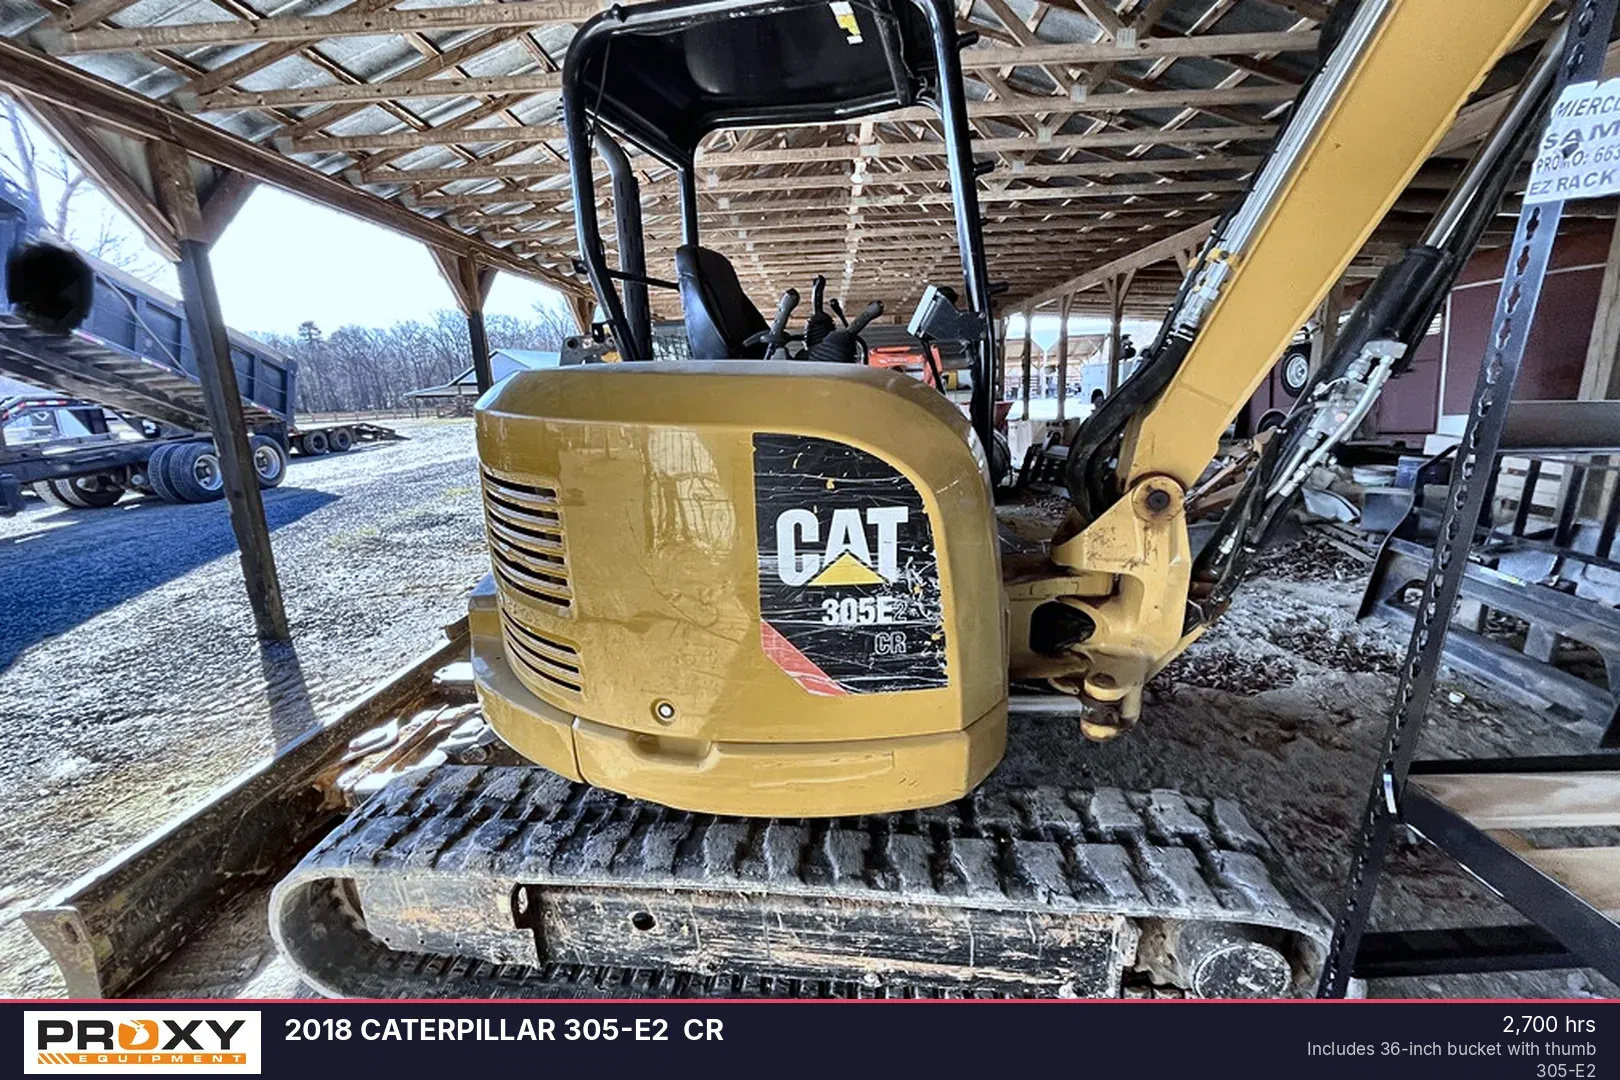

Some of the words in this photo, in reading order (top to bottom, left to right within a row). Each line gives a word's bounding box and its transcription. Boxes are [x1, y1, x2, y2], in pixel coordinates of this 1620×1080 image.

[1529, 180, 1552, 196] EZ
[1556, 168, 1617, 192] RACK
[776, 506, 909, 587] CAT
[874, 631, 907, 655] CR
